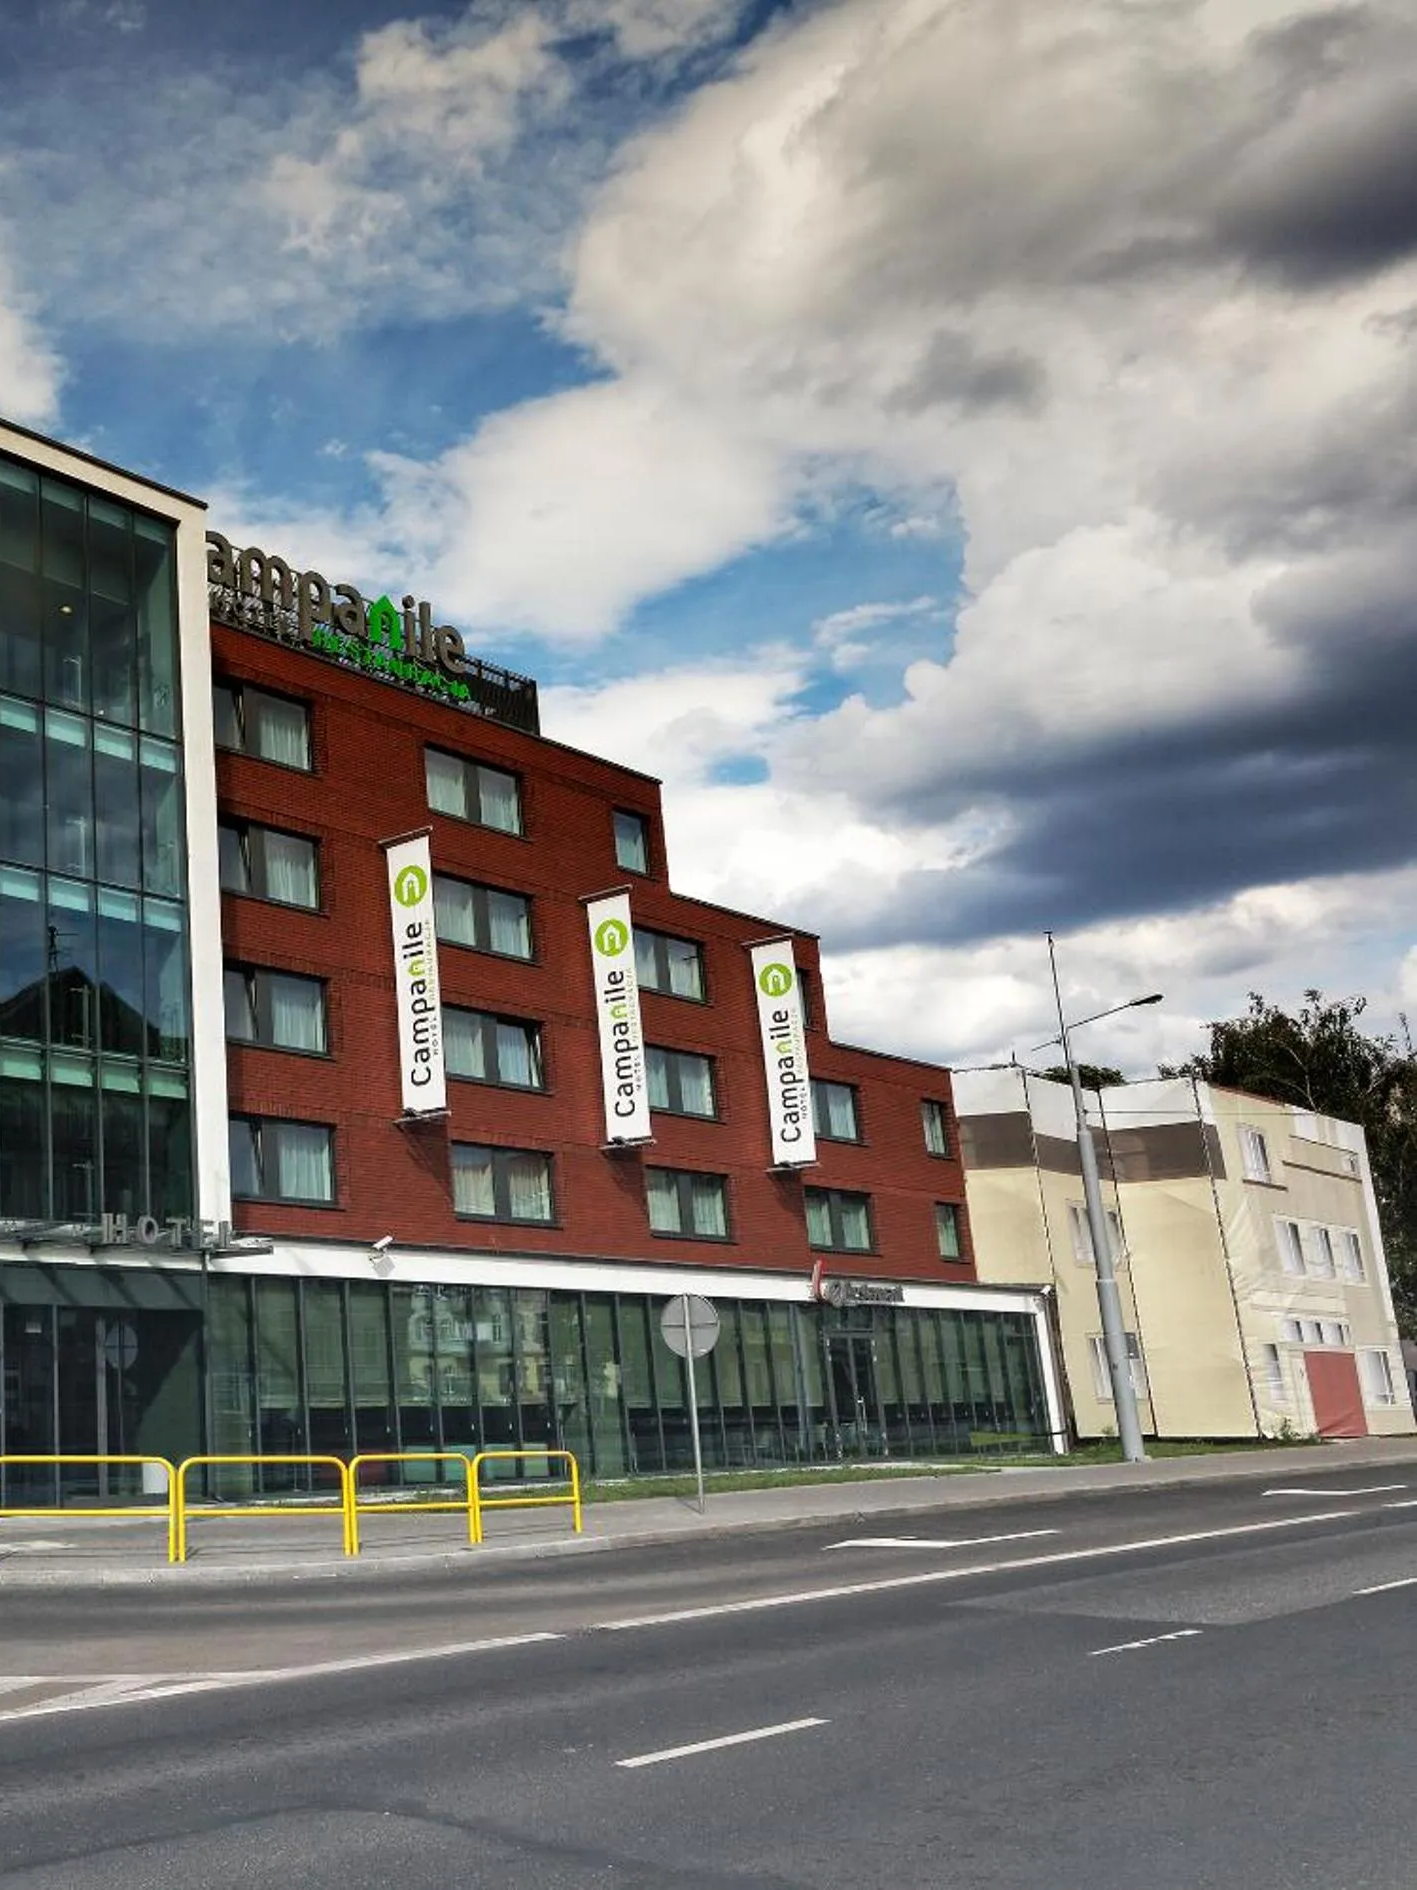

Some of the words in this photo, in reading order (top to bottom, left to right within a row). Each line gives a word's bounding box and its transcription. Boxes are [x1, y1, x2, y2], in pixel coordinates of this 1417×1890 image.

[205, 530, 468, 676] ampanile
[402, 922, 435, 1087] Campanile
[604, 970, 639, 1118] Campanile
[768, 1010, 804, 1143] Campanile
